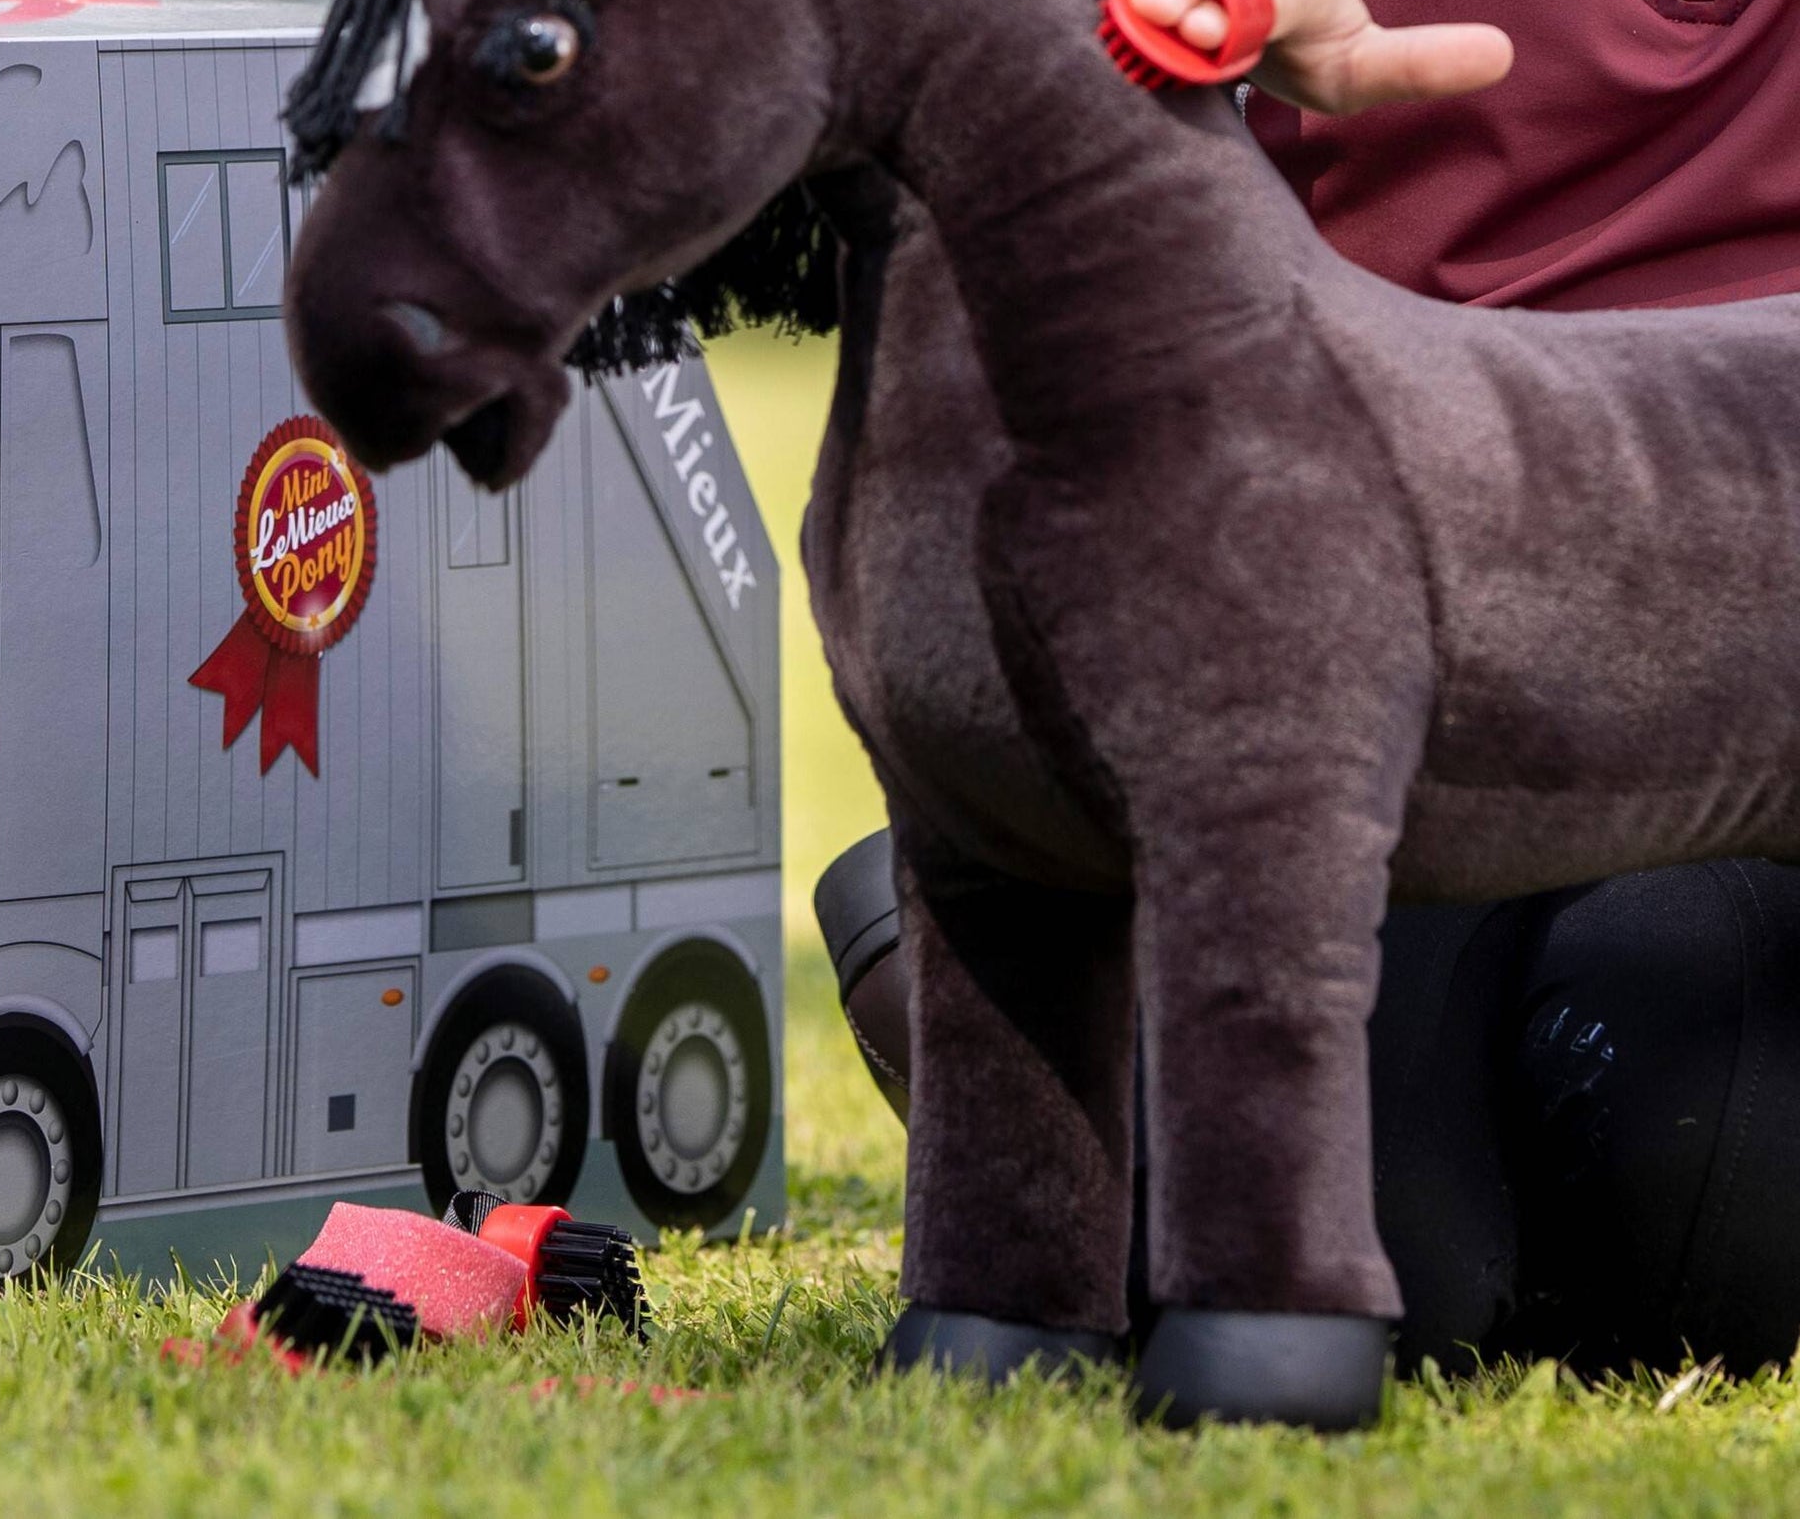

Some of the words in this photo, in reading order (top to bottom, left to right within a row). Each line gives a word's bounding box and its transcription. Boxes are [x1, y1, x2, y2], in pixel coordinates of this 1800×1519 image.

[274, 459, 333, 520] Mini
[640, 358, 757, 612] Mieux
[250, 492, 357, 576] LeMieux
[272, 525, 356, 622] Pony
